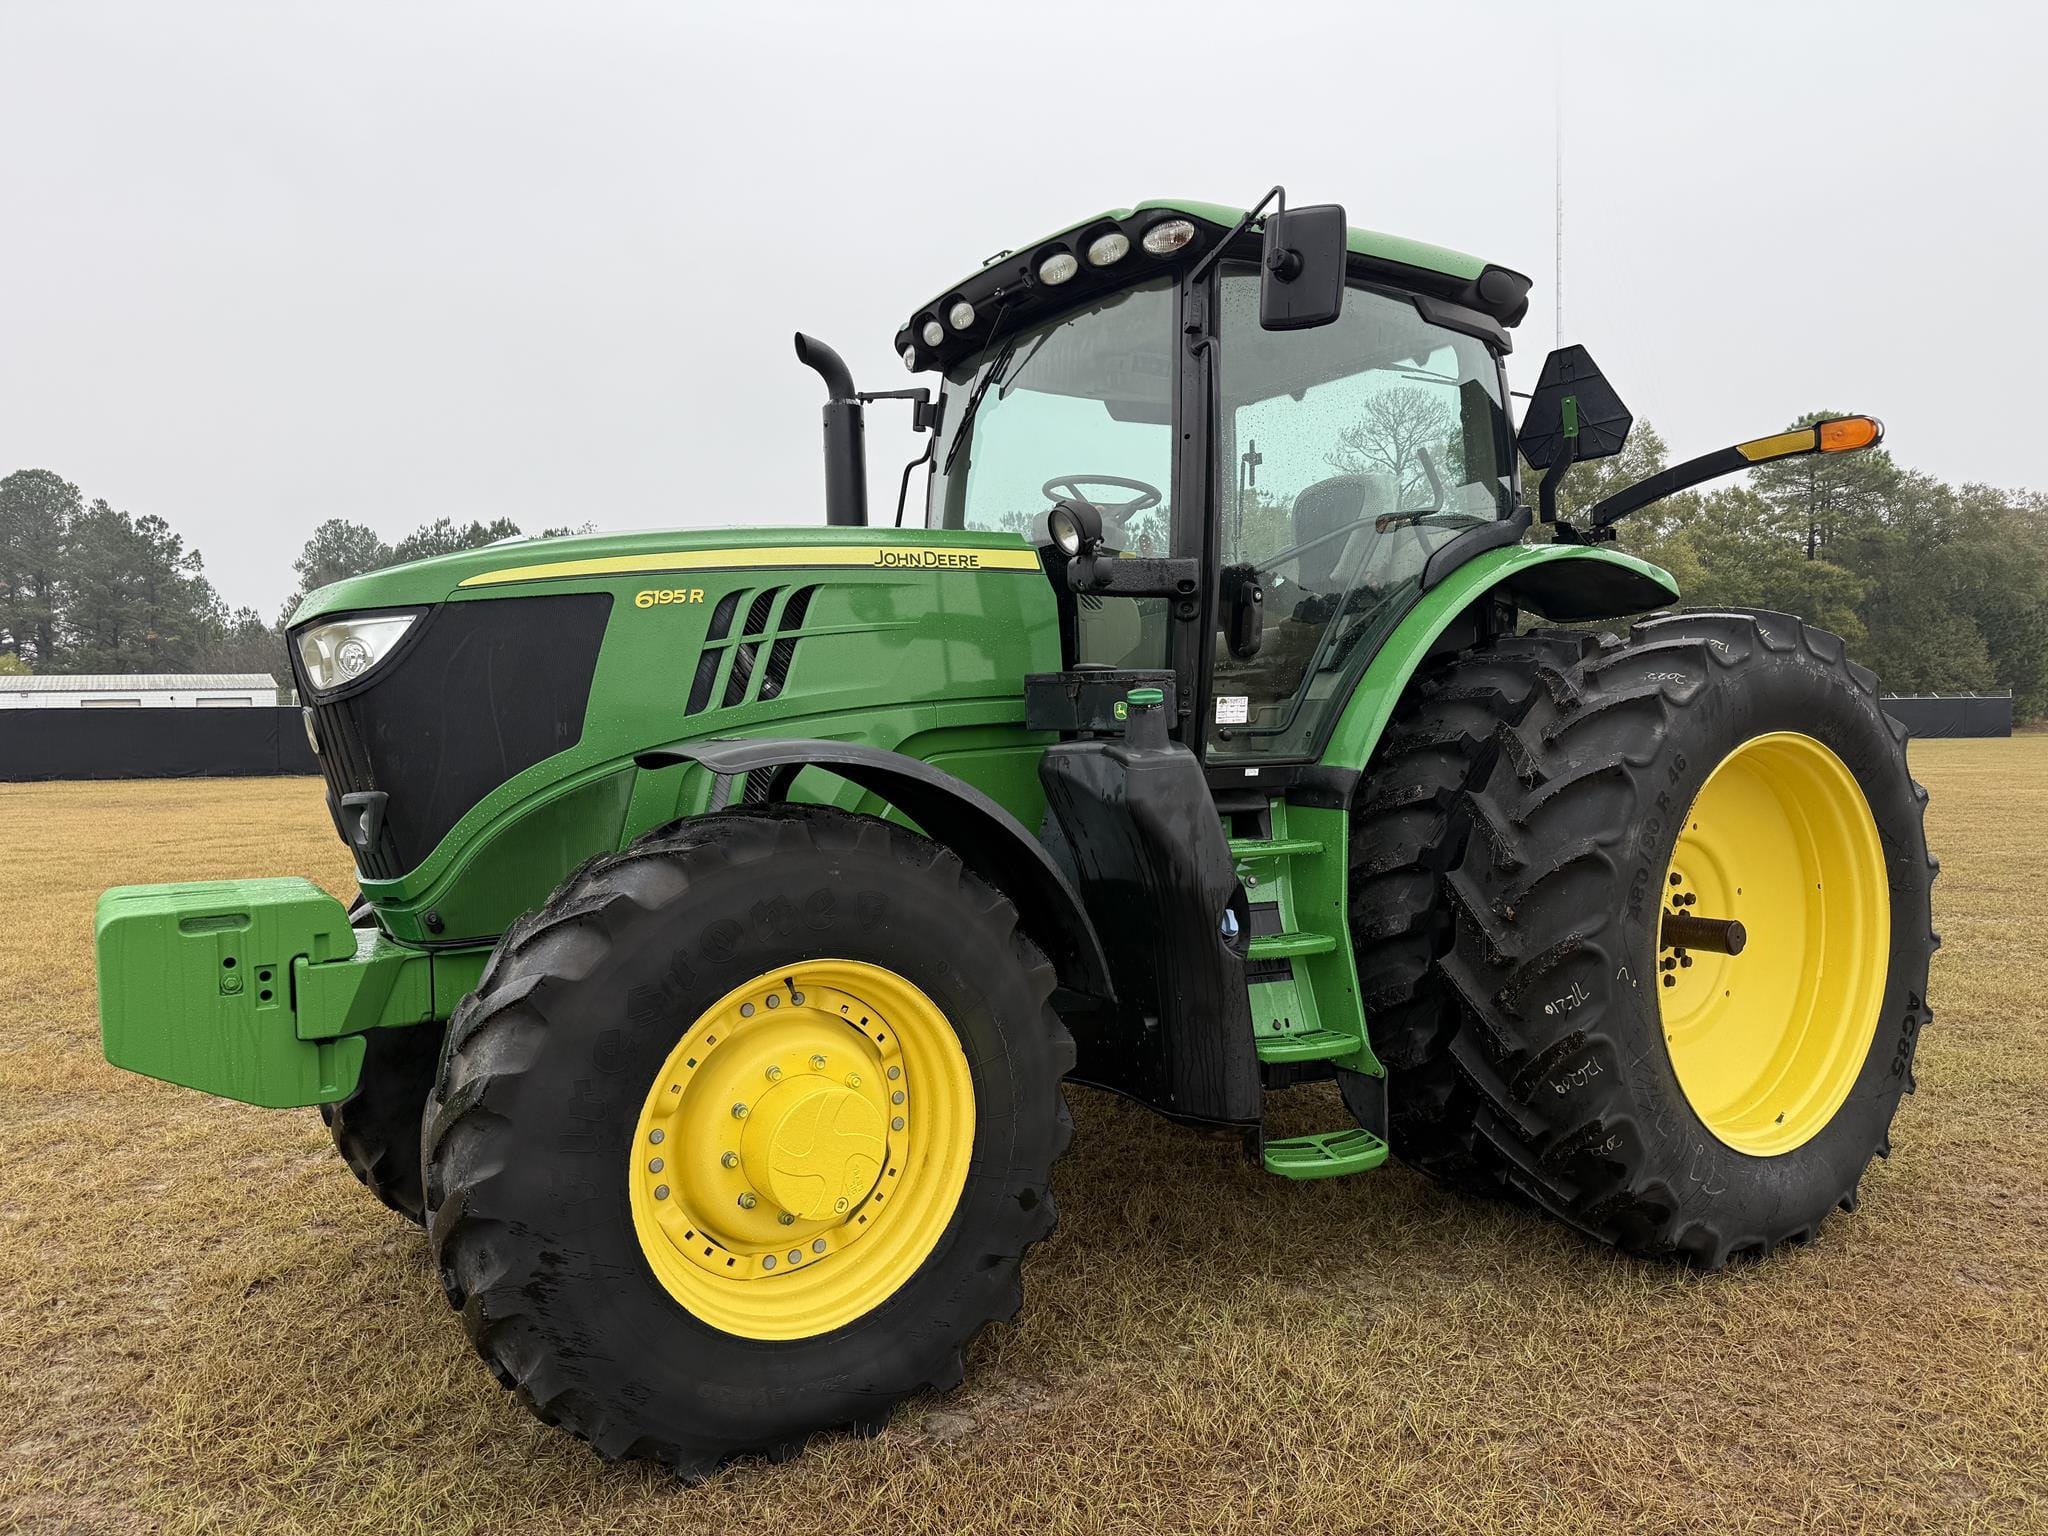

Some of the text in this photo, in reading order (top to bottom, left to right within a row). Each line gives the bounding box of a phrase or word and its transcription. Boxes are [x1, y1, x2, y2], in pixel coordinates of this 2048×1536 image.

[874, 550, 980, 569] JOHN DEERE
[634, 588, 705, 609] 6195 R
[1668, 753, 1688, 786] 46
[1891, 990, 1921, 1078] AC85
